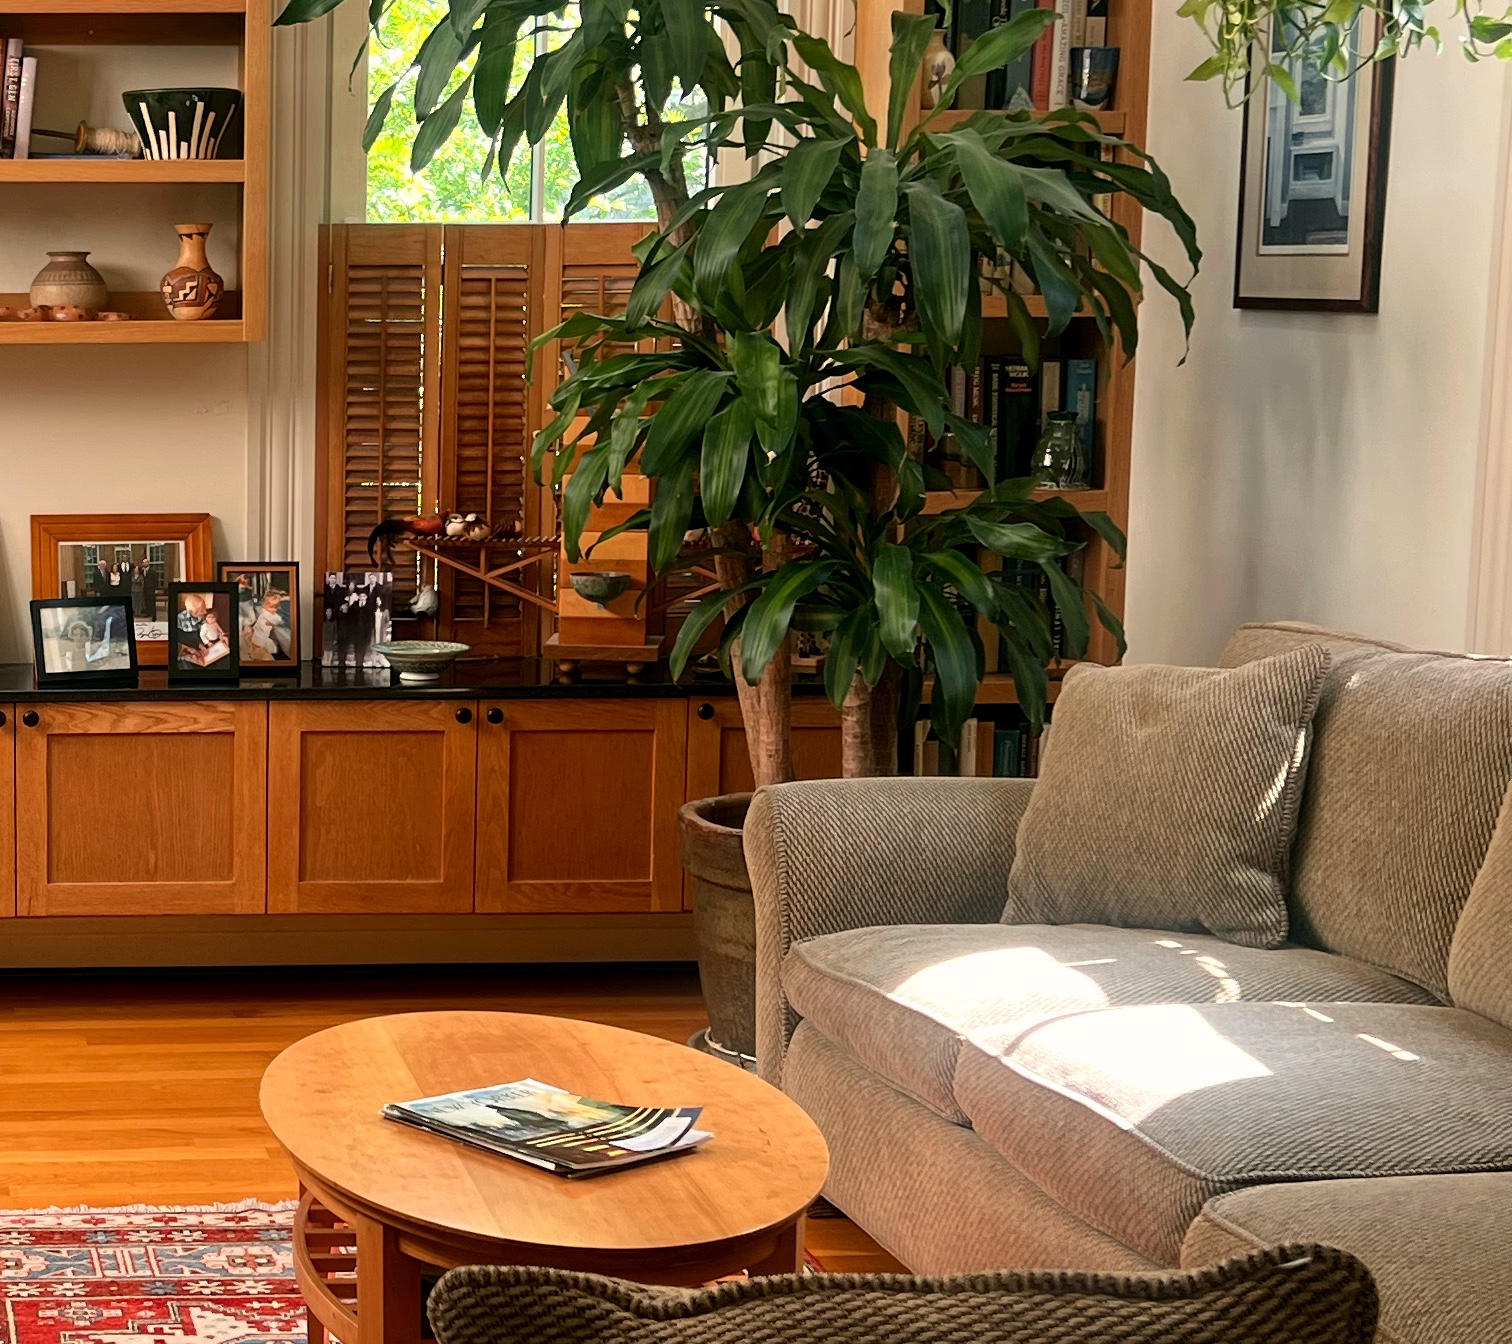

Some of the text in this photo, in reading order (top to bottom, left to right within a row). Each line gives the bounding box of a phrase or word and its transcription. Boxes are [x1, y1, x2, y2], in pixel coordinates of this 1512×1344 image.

[1058, 22, 1068, 63] AMAZING
[7, 84, 18, 102] GEN
[1056, 65, 1065, 97] GRACE
